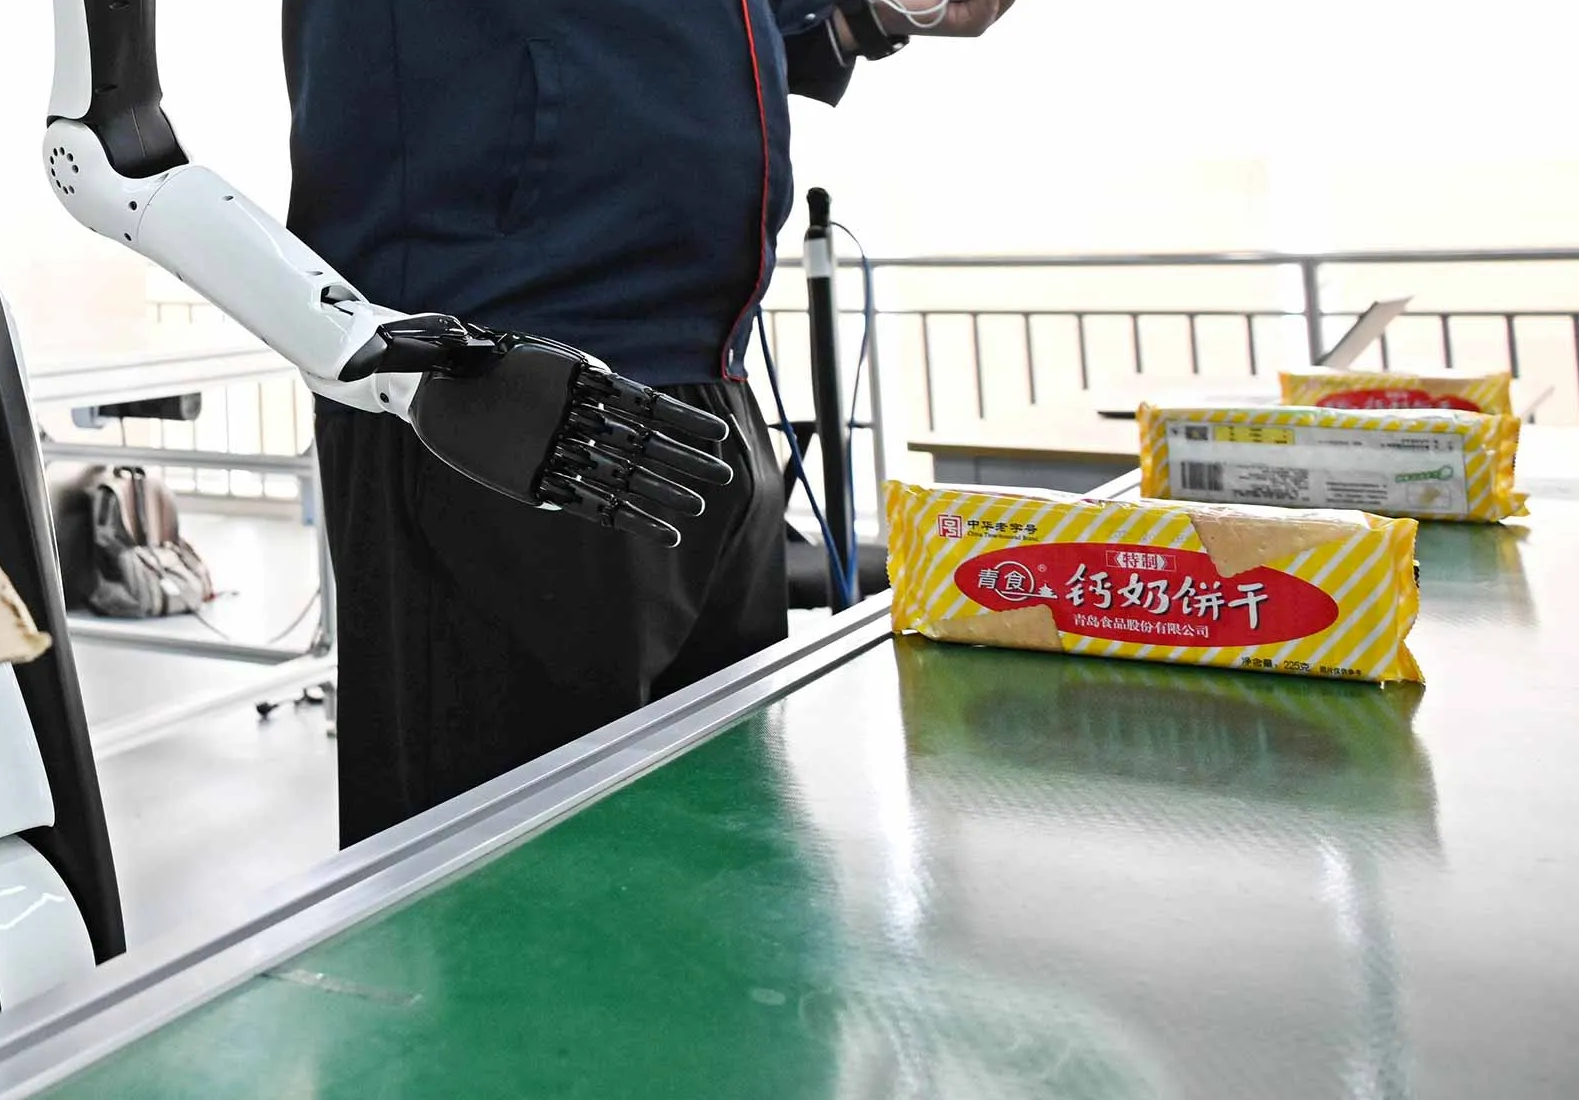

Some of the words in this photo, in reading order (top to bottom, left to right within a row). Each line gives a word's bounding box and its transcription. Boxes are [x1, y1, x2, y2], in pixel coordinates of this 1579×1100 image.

[967, 520, 1037, 534] 中华老字号
[1122, 552, 1159, 570] 特制
[977, 568, 1026, 592] 青食
[1065, 563, 1269, 630] 钙奶饼干
[1073, 613, 1210, 638] 青岛食品股份有限公司
